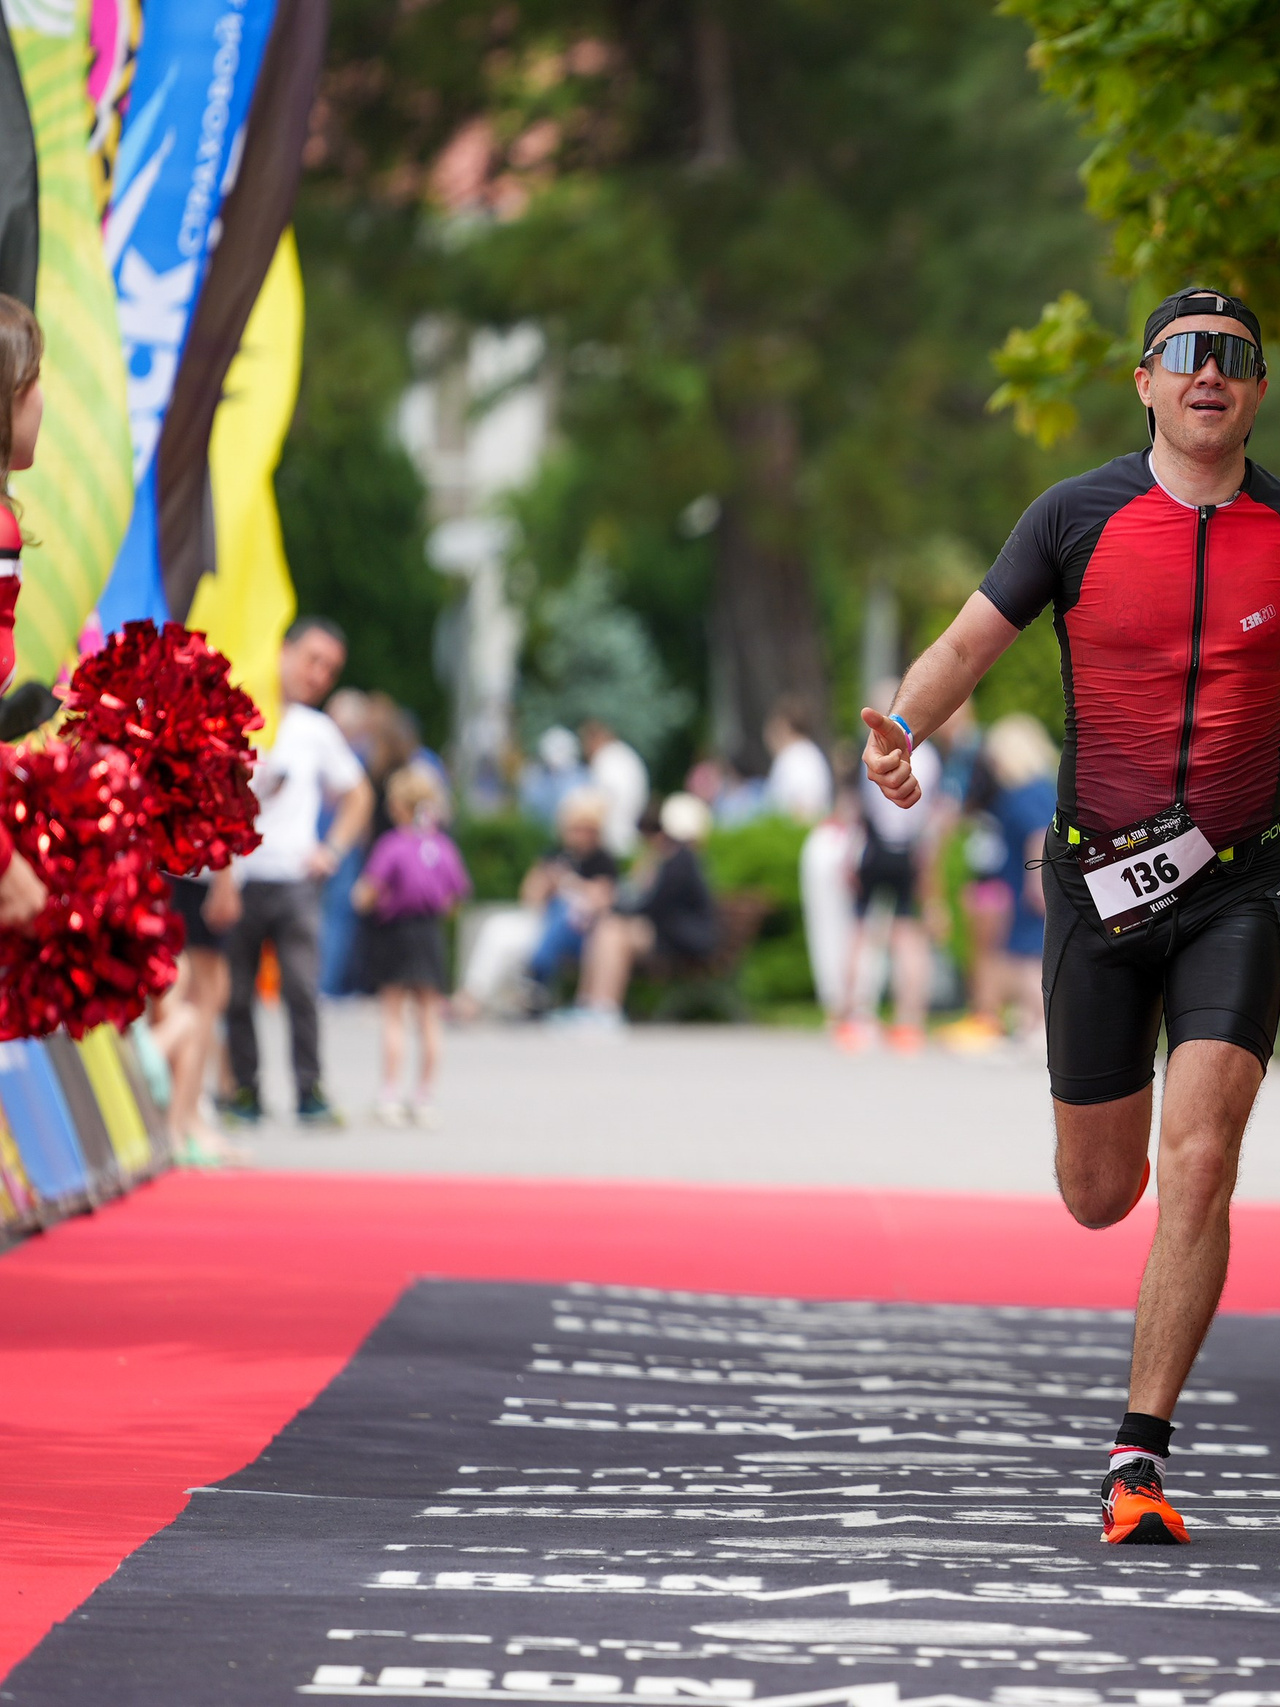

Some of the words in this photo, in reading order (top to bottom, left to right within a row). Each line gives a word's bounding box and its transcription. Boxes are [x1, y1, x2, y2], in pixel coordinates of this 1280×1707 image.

[1111, 834, 1128, 849] IRON
[1130, 827, 1149, 842] STAR
[1120, 852, 1180, 899] 136
[1149, 893, 1179, 914] KIRILL
[373, 1570, 766, 1593] IRON
[312, 1664, 757, 1699] IRON
